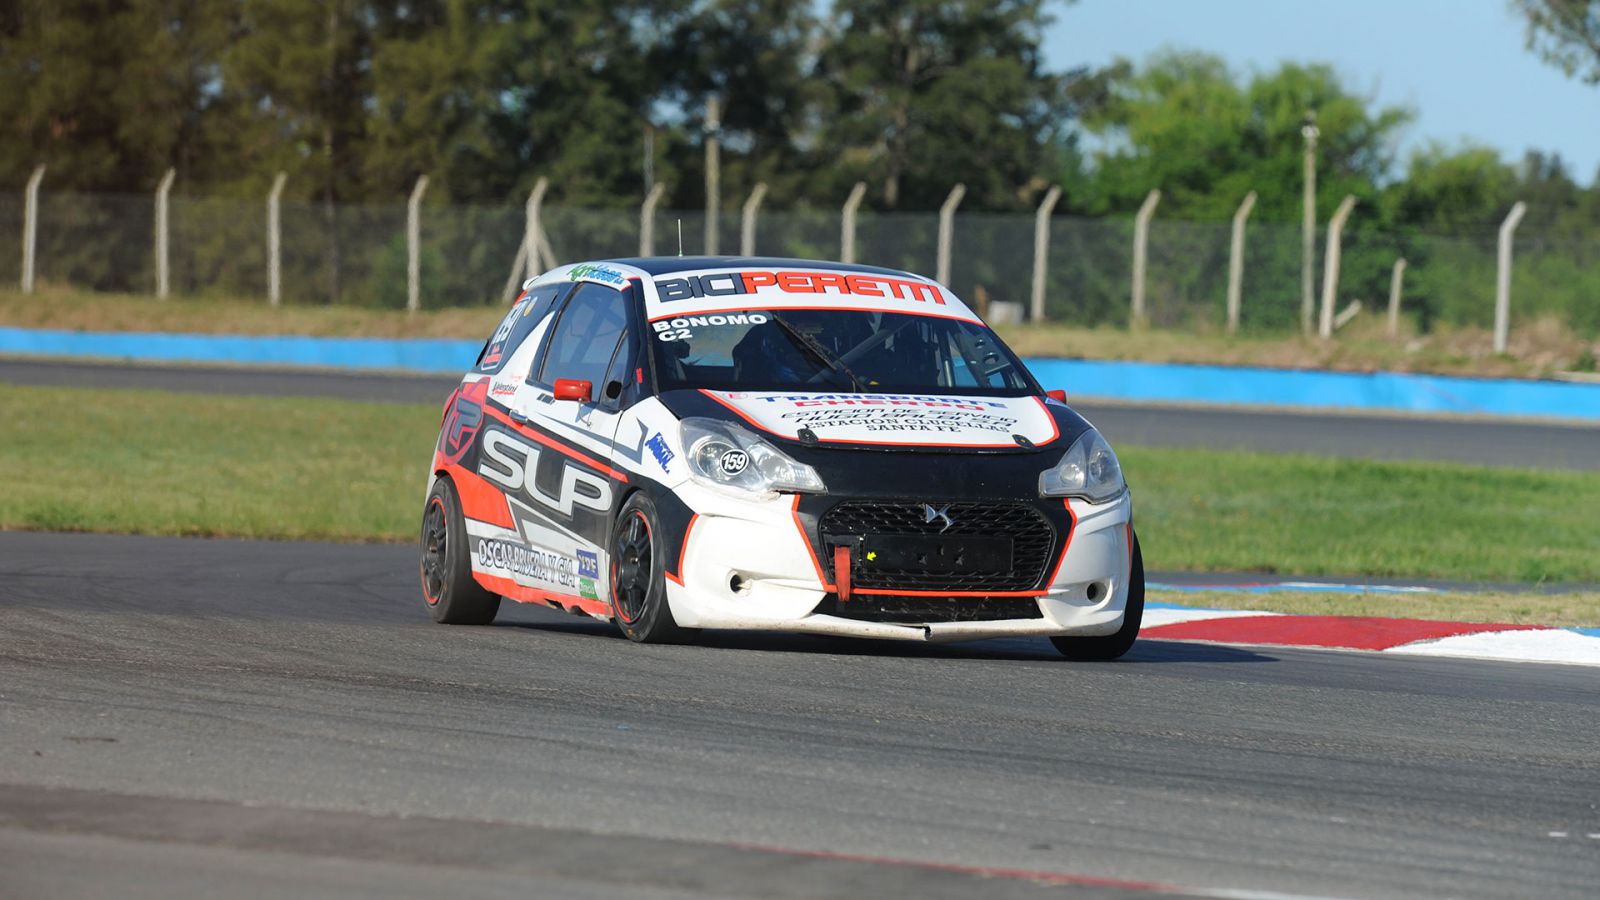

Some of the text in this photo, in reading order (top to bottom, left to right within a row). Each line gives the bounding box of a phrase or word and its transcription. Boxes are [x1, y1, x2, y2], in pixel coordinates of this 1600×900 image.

[652, 314, 768, 333] BONOMO
[658, 328, 693, 342] C2
[756, 395, 1008, 408] TRANSPORTE
[781, 408, 885, 419] ESTACION
[927, 410, 1018, 424] SERVICIO
[795, 413, 872, 423] HUGO
[803, 418, 1010, 433] ESTACION CLUCELLAS
[936, 425, 962, 433] FE
[722, 454, 747, 471] 159
[479, 429, 613, 516] SLP
[479, 538, 513, 571] OSCAR
[548, 554, 557, 583] Y
